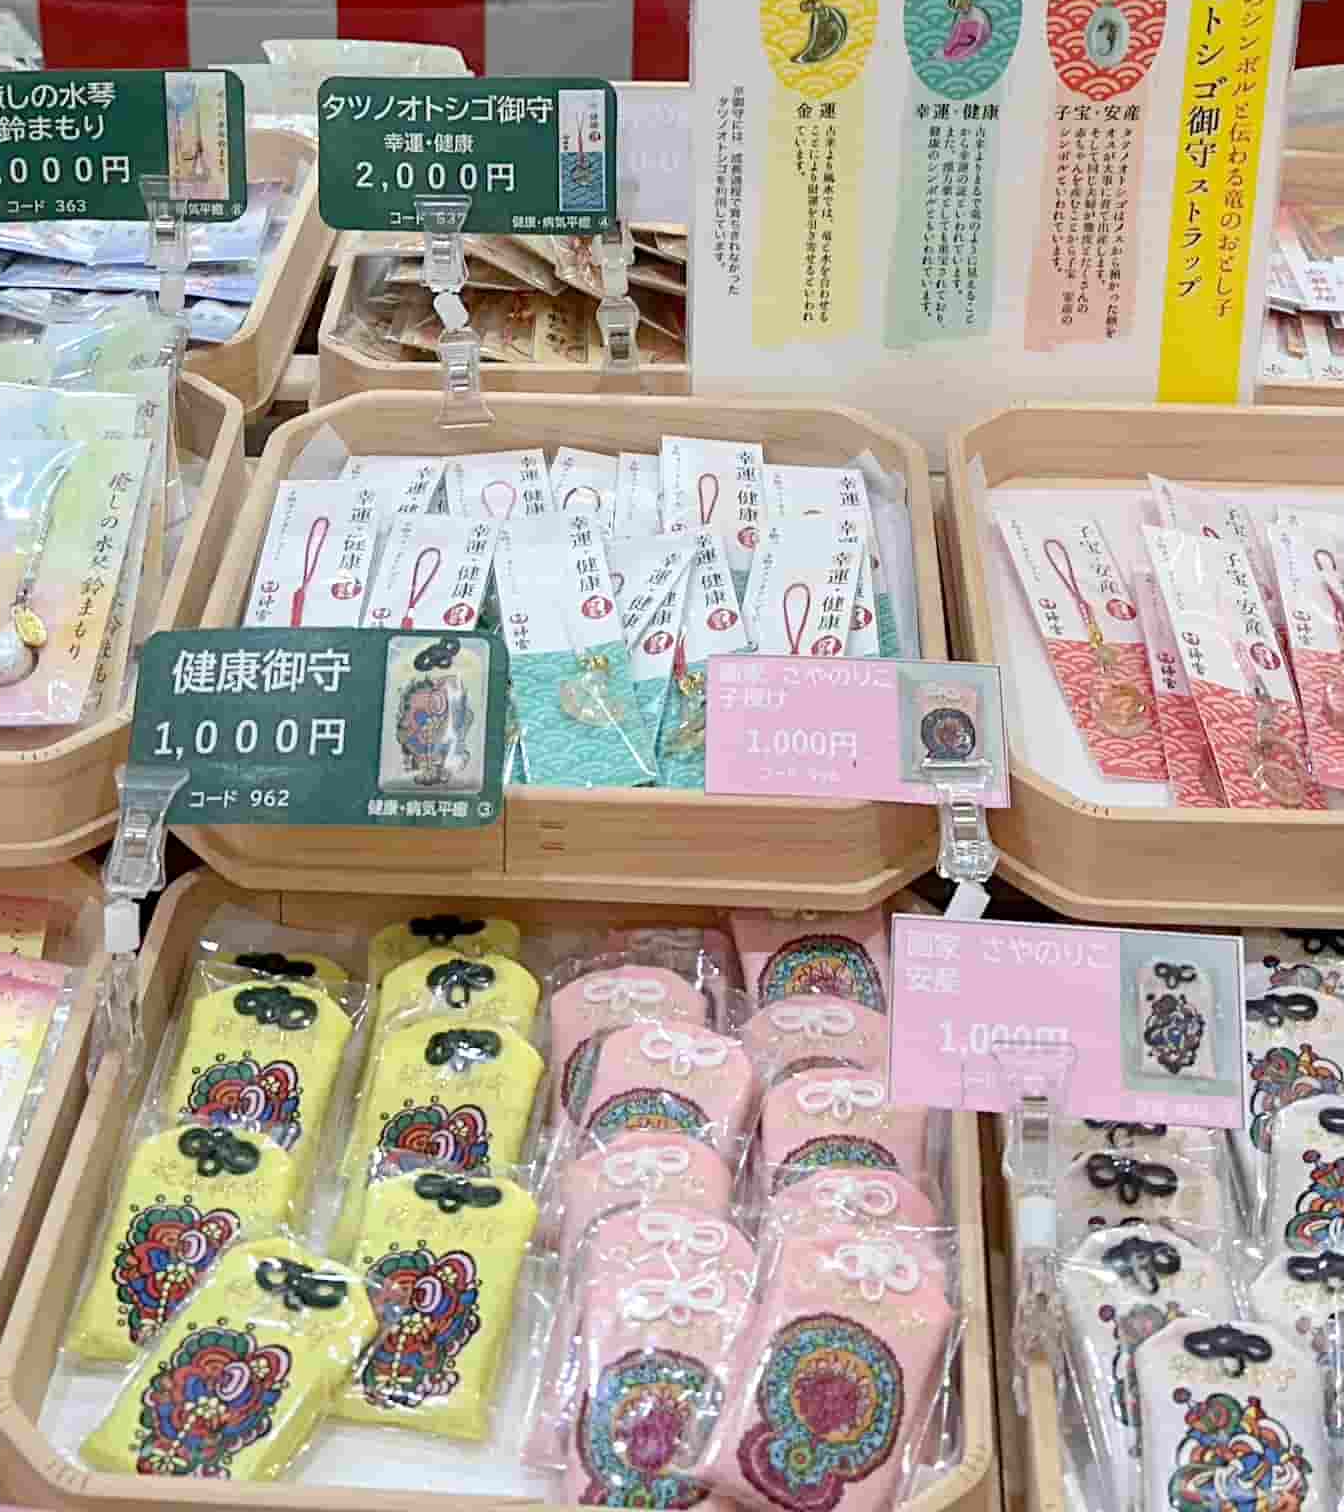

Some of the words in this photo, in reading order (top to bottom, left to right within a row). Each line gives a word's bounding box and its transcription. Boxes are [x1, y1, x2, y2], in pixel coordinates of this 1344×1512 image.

[322, 94, 554, 124] タツノオトシゴ御守
[796, 102, 837, 120] 金運
[1055, 103, 1140, 121] 子宝・安産
[383, 132, 475, 155] 幸運・健康
[356, 161, 516, 193] 2,000円
[7, 200, 46, 213] コード
[55, 199, 87, 213] 363
[172, 648, 352, 696] 健康御守
[154, 718, 346, 760] 1,000円
[189, 790, 238, 809] コード
[250, 789, 289, 808] 962
